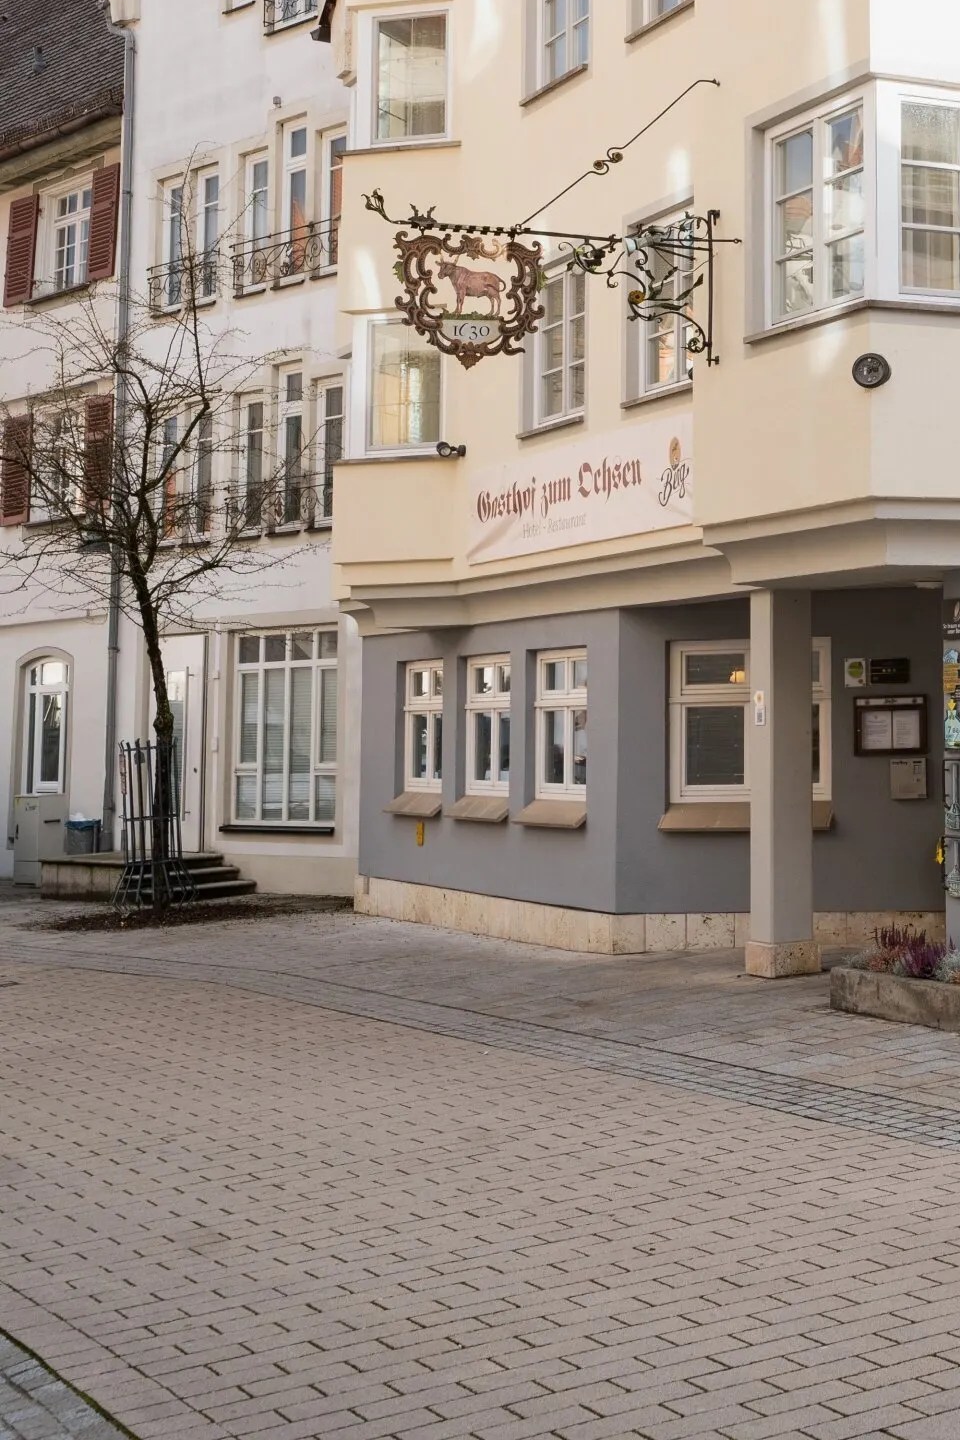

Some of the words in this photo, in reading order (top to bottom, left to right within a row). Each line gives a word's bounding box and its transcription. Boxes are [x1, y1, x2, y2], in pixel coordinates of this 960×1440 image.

[453, 323, 490, 340] 1630
[477, 476, 537, 523] Gasthof
[540, 476, 571, 517] zum
[577, 456, 642, 504] Ochsen
[658, 462, 689, 507] Berg
[522, 520, 541, 539] Hotel
